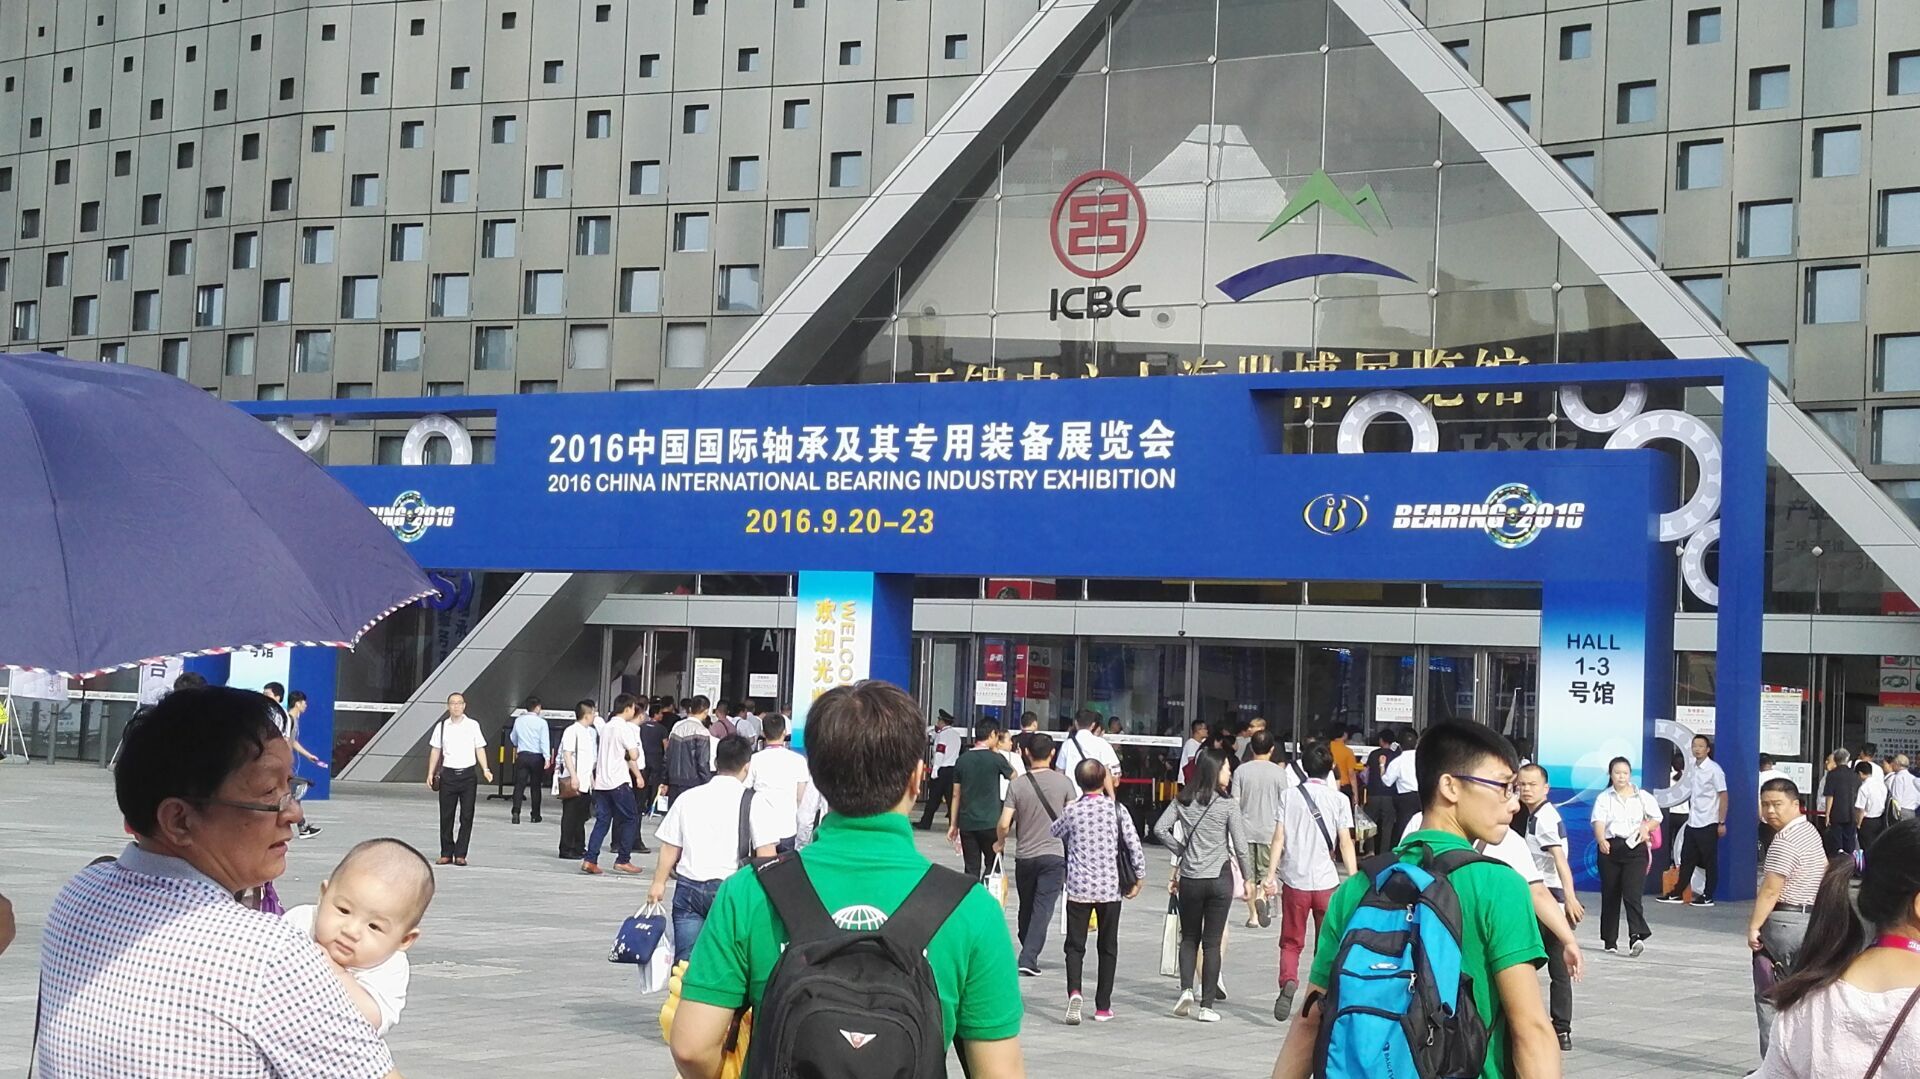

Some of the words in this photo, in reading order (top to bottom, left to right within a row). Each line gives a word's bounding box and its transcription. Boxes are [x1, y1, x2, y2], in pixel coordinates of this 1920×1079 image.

[1050, 285, 1141, 321] ICBC
[549, 419, 1176, 466] 2016中国国际轴承及其专用装备展览会
[548, 474, 591, 492] 2016
[596, 473, 656, 492] CHINA
[661, 472, 821, 491] INTERNATIONAL
[826, 470, 921, 490] BEARING
[927, 469, 1038, 490] INDUSTRY
[1043, 468, 1176, 489] EXHIBITION
[411, 506, 456, 527] 2016
[745, 508, 935, 534] 2016.9.20-23
[1393, 503, 1507, 529] BEARING
[1515, 503, 1585, 529] 2016
[1567, 633, 1621, 650] HALL
[1575, 657, 1610, 676] 1-3
[1568, 681, 1616, 705] 号馆
